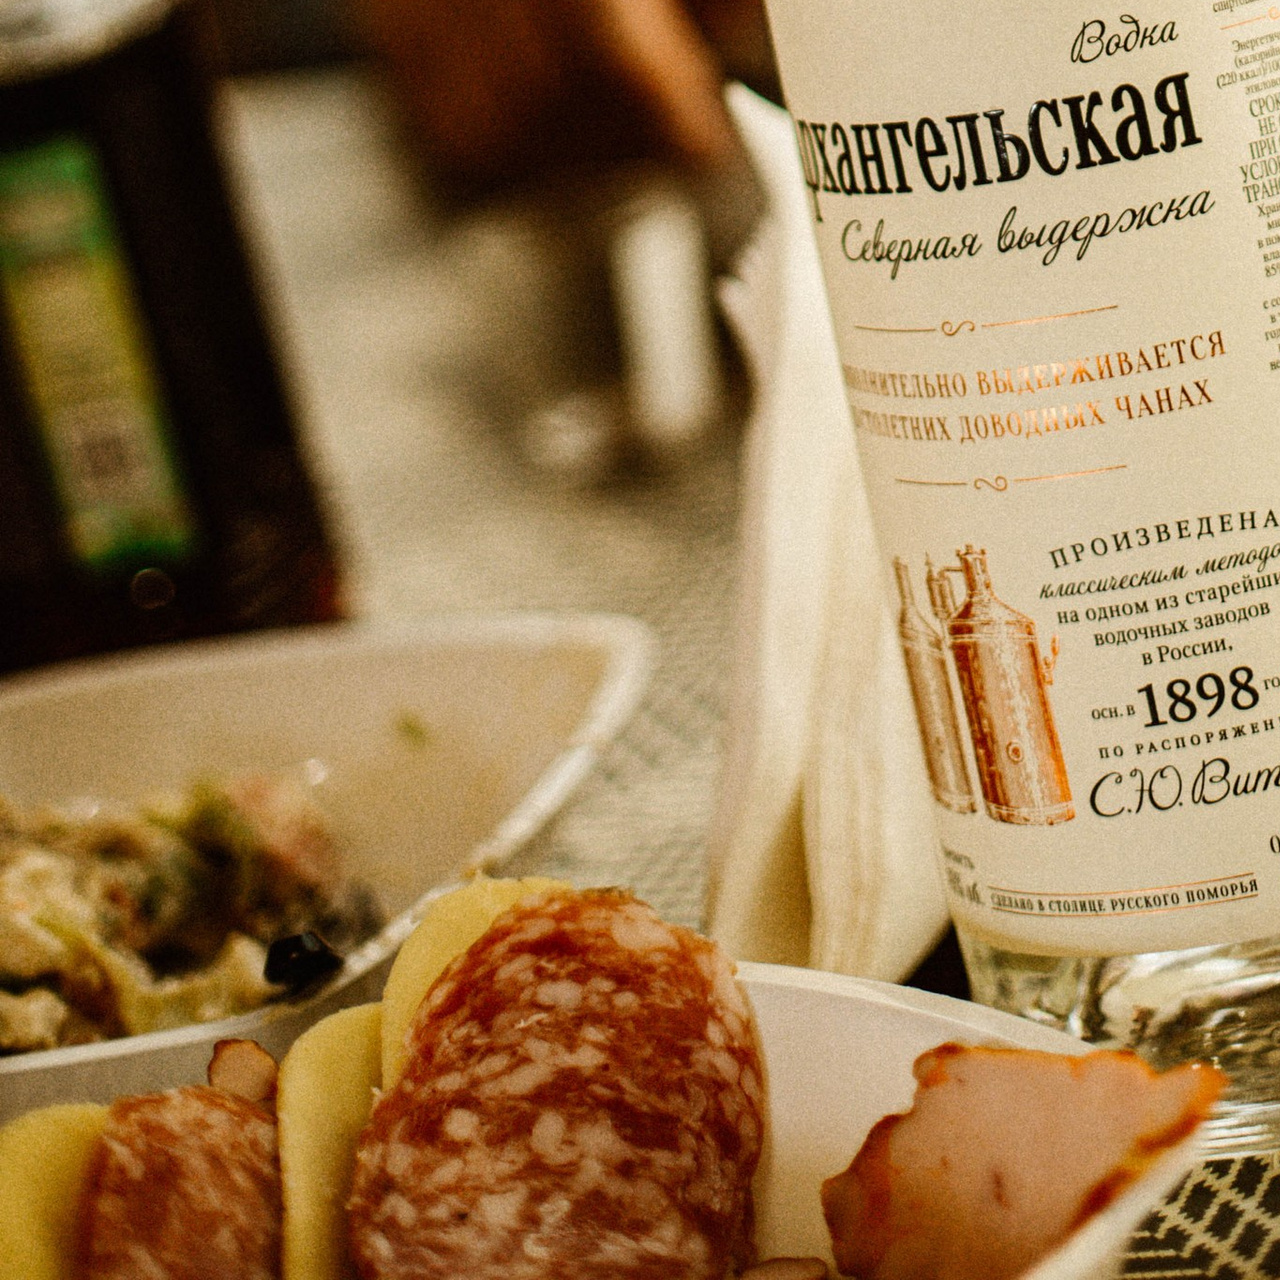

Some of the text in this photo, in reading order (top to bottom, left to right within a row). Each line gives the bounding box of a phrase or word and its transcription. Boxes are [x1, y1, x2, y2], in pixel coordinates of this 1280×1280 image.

[1070, 14, 1179, 64] Водка
[795, 71, 1203, 222] рхангельская
[1249, 136, 1277, 160] ПРИ
[1258, 114, 1277, 137] НЕ
[840, 189, 1216, 280] Северная выдержка
[977, 329, 1228, 396] ВЫДЕРЖИВАЕТСЯ
[960, 400, 1106, 445] ДОВОДНЫХ
[1115, 377, 1214, 421] ЧАНАХ
[1048, 508, 1280, 569] ПРОИЗВЕДЕНА
[1039, 563, 1189, 599] классическим
[1057, 608, 1080, 625] на
[1085, 598, 1150, 622] одном
[1156, 593, 1180, 610] из
[1093, 601, 1272, 647] водочных заводов
[1141, 637, 1234, 666] в России,
[1136, 664, 1260, 729] 1898
[1099, 745, 1125, 759] ПО
[1037, 899, 1045, 912] В
[1048, 898, 1105, 914] СТОЛИЦЕ
[1110, 892, 1181, 912] РУССКОГО
[1186, 878, 1259, 904] ПОМОРЬЯ
